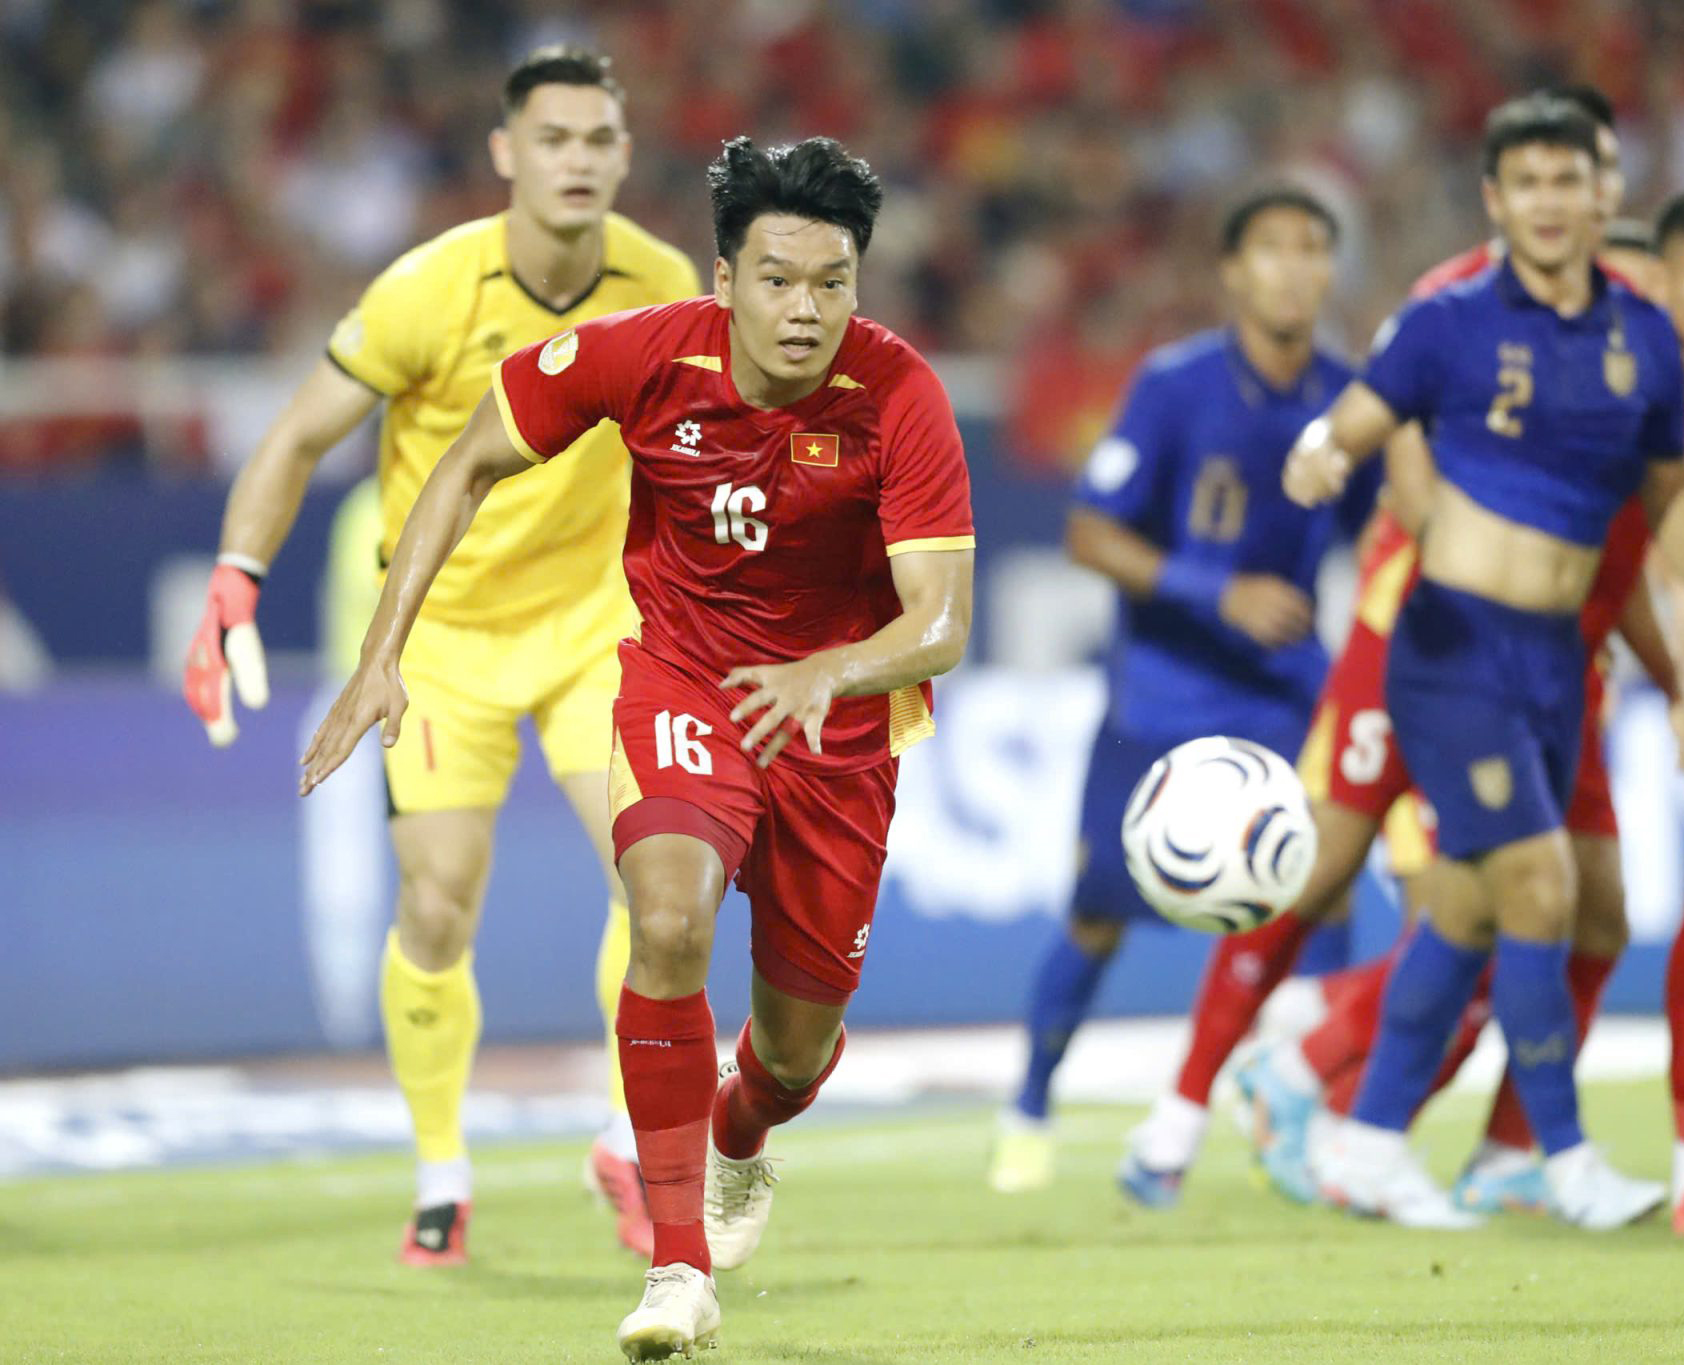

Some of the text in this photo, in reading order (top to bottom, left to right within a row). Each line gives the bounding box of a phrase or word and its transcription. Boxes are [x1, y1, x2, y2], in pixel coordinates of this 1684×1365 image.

[1486, 370, 1532, 437] 2
[711, 482, 768, 551] 16
[655, 709, 713, 775] 16
